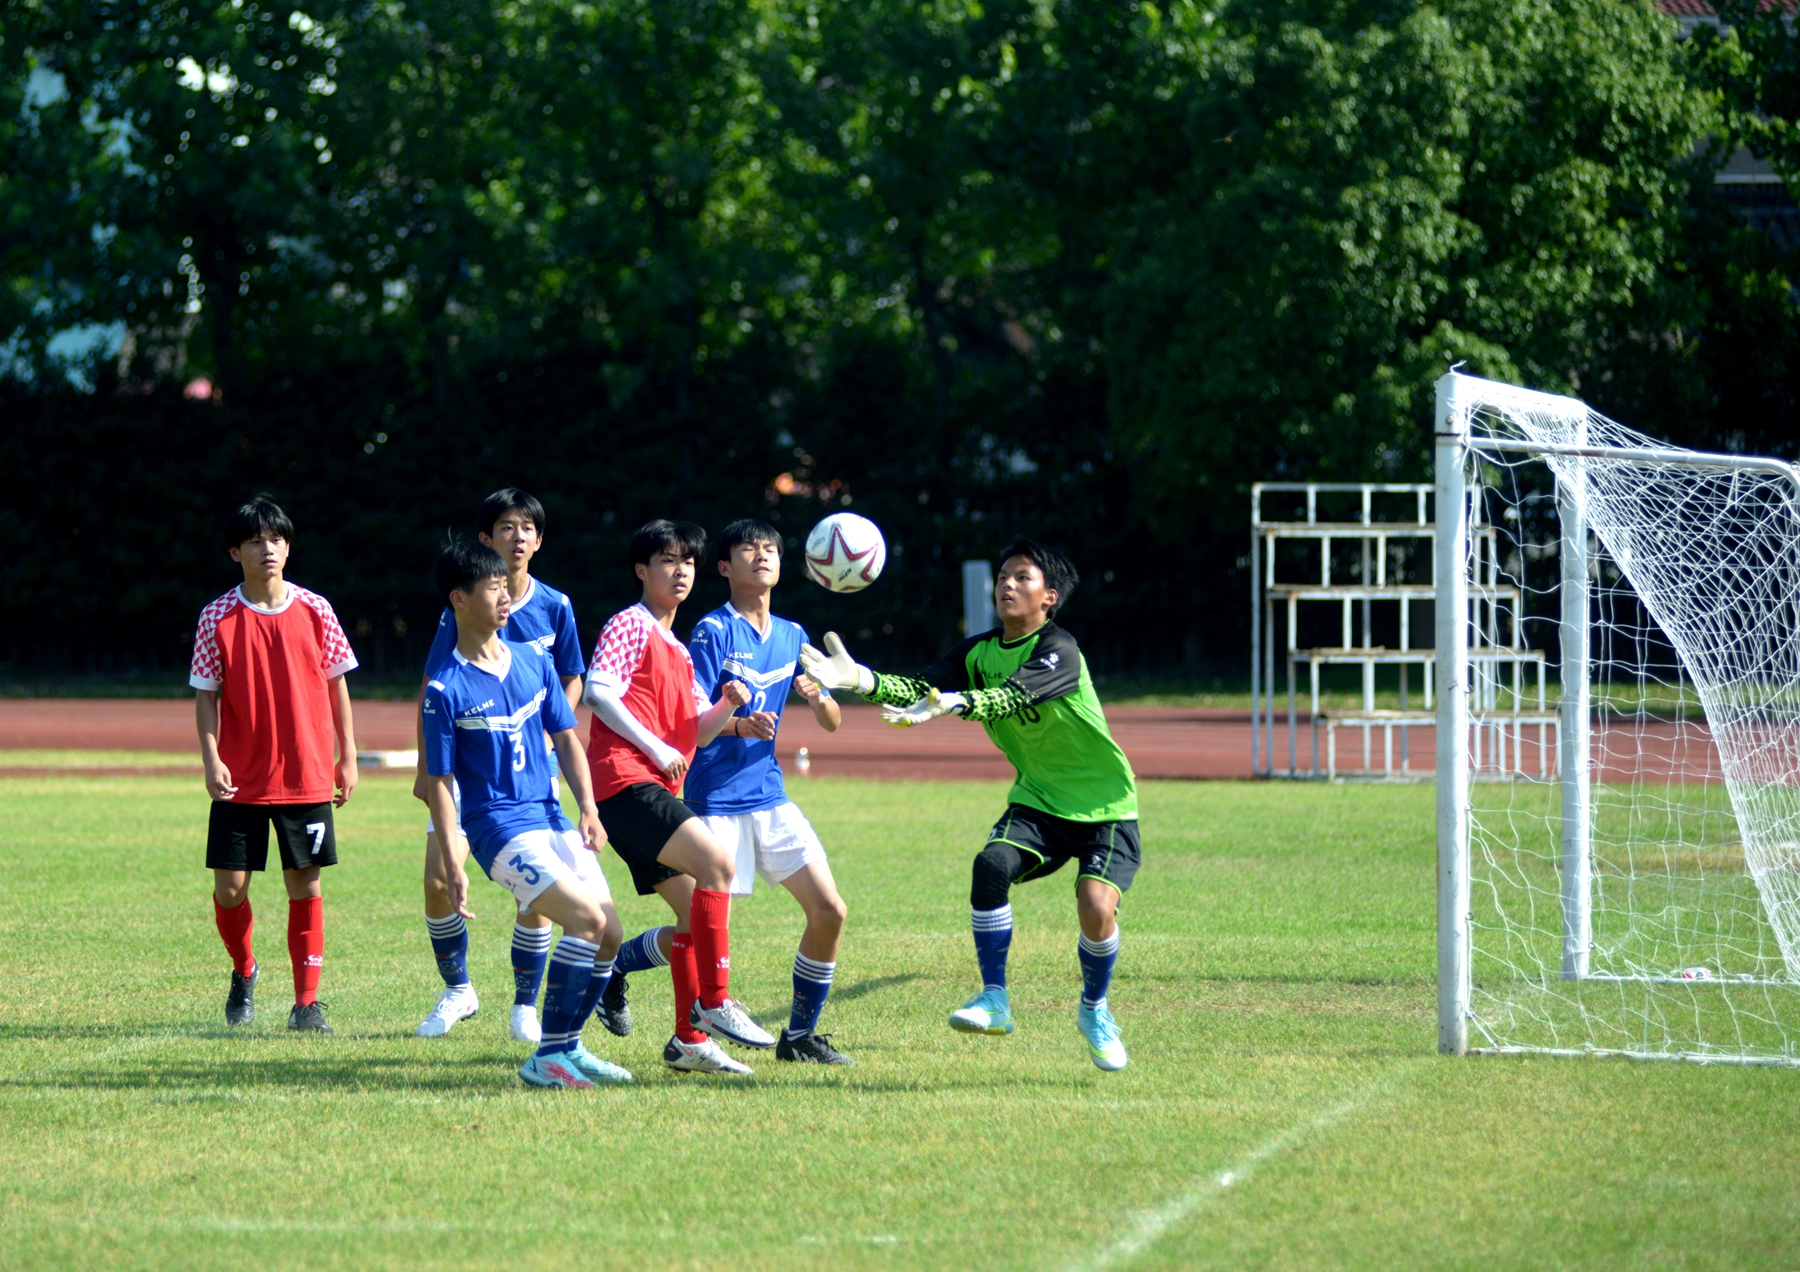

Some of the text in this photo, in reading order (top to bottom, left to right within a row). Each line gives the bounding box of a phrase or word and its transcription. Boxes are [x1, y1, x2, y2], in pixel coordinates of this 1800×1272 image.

[729, 651, 754, 660] KELME
[464, 699, 496, 717] KELME
[508, 730, 526, 772] 3
[306, 822, 326, 854] 7
[508, 853, 540, 886] 3
